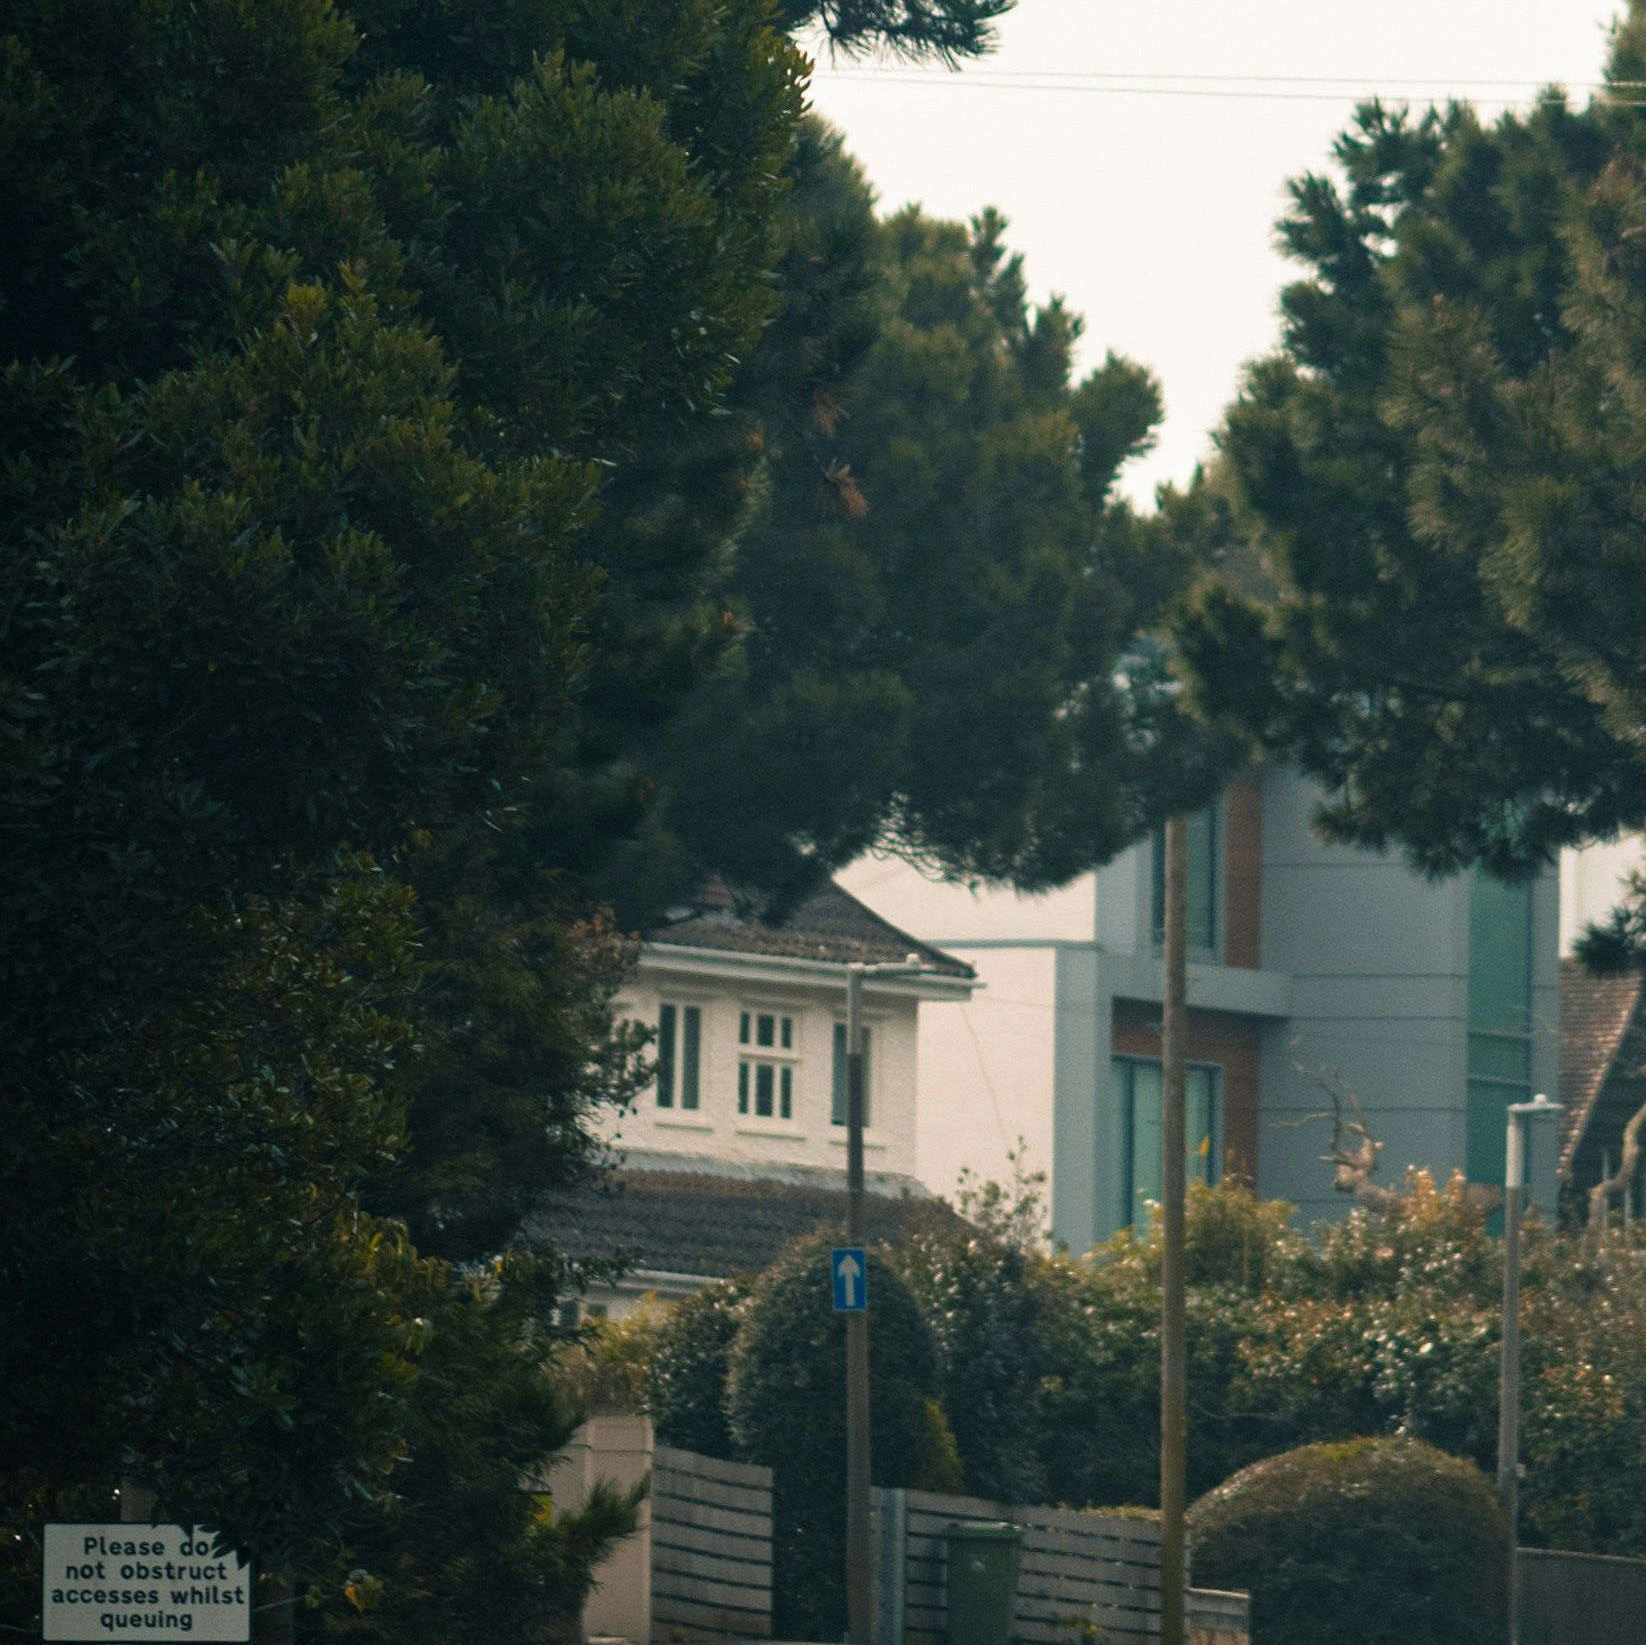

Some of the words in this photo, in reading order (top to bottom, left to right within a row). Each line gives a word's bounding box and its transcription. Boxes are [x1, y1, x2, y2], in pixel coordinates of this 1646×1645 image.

[83, 1537, 165, 1555] Please
[180, 1537, 209, 1555] do
[65, 1561, 106, 1580] not
[120, 1561, 227, 1580] obstruct
[51, 1588, 159, 1604] accesses
[170, 1586, 245, 1605] whilst
[100, 1610, 193, 1632] queuing
